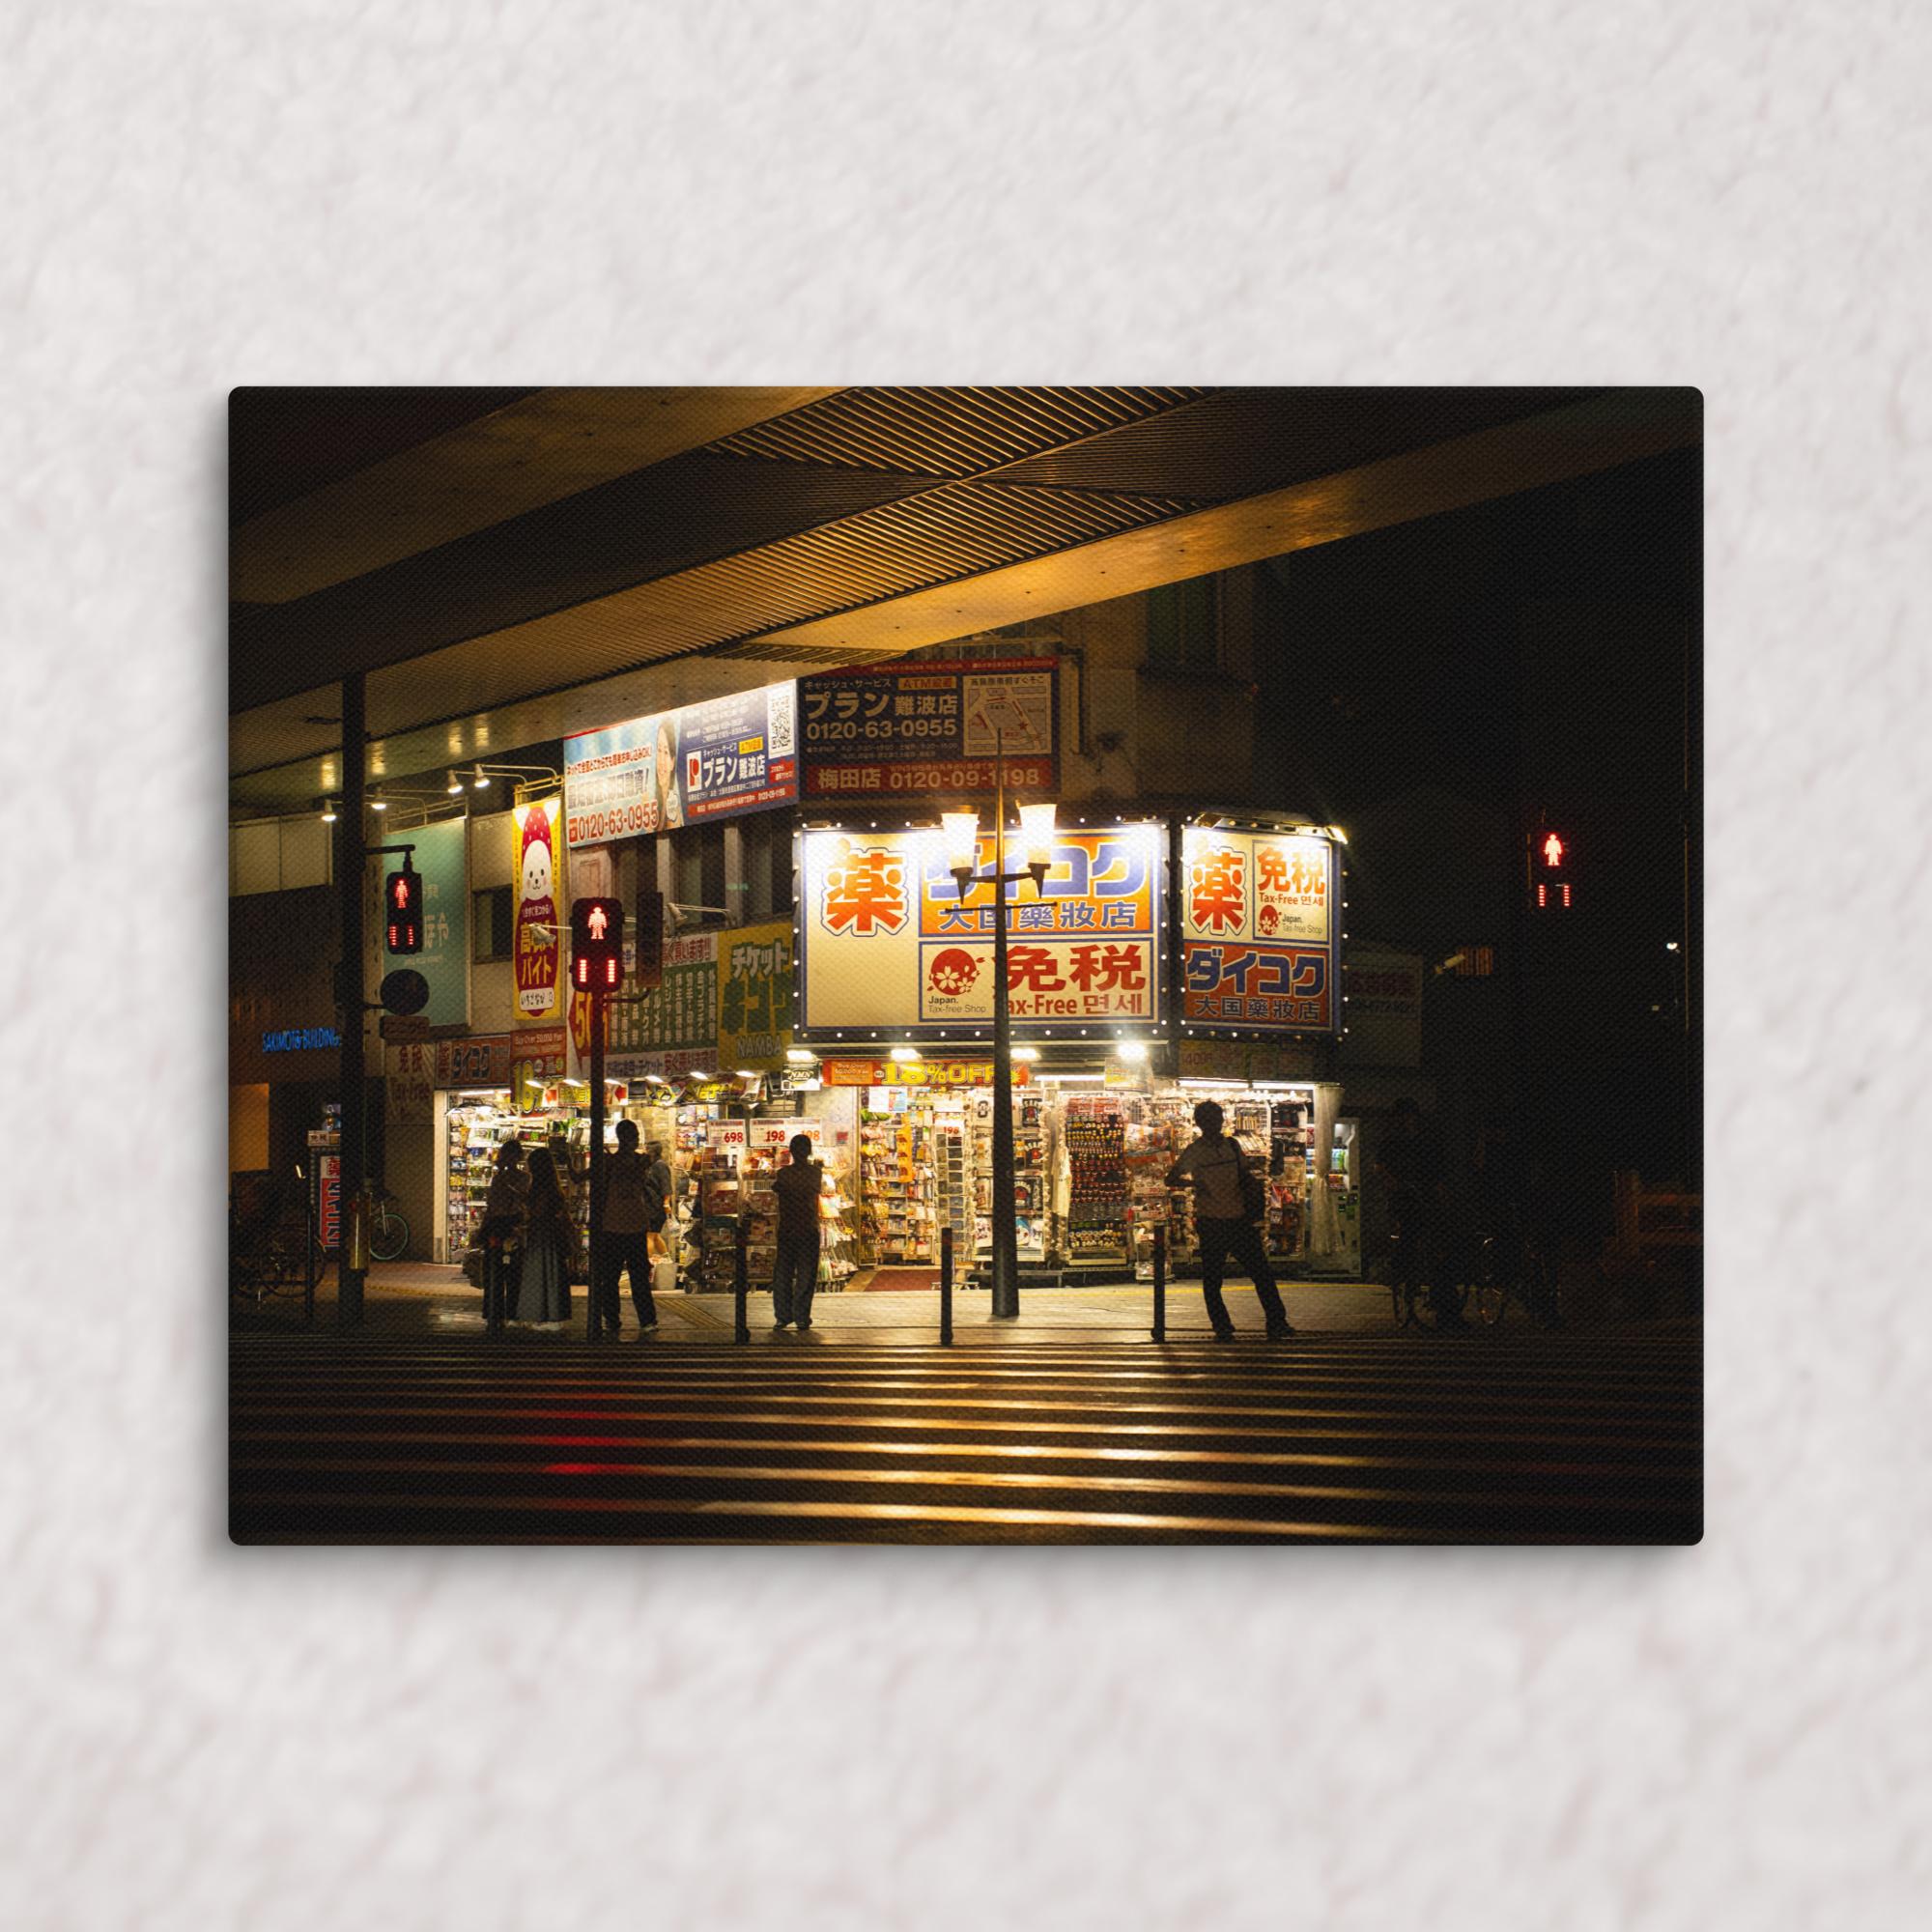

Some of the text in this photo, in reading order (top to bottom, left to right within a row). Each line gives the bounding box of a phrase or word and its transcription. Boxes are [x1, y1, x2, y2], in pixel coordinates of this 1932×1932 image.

[805, 678, 891, 689] キャッシュ・サービス
[805, 691, 957, 719] プラン 難波店
[807, 719, 957, 740] 0120-63-0955
[818, 768, 881, 789] 梅田店
[890, 768, 1039, 788] 0120-09-1198
[579, 800, 659, 841] 0120-63-0955
[1257, 846, 1326, 895] 免税
[824, 849, 907, 933] 薬
[1191, 850, 1245, 931] 薬
[1259, 893, 1298, 904] Tax-Free
[732, 941, 788, 978] チケット
[992, 944, 1147, 992] 免税
[1186, 947, 1326, 998] ダイコク
[927, 996, 959, 1006] Japan.
[964, 1005, 987, 1014] Shop
[1001, 995, 1077, 1015] ax-Free
[737, 1035, 782, 1060] NAMBA
[724, 1131, 744, 1144] 698
[765, 1130, 785, 1143] 198
